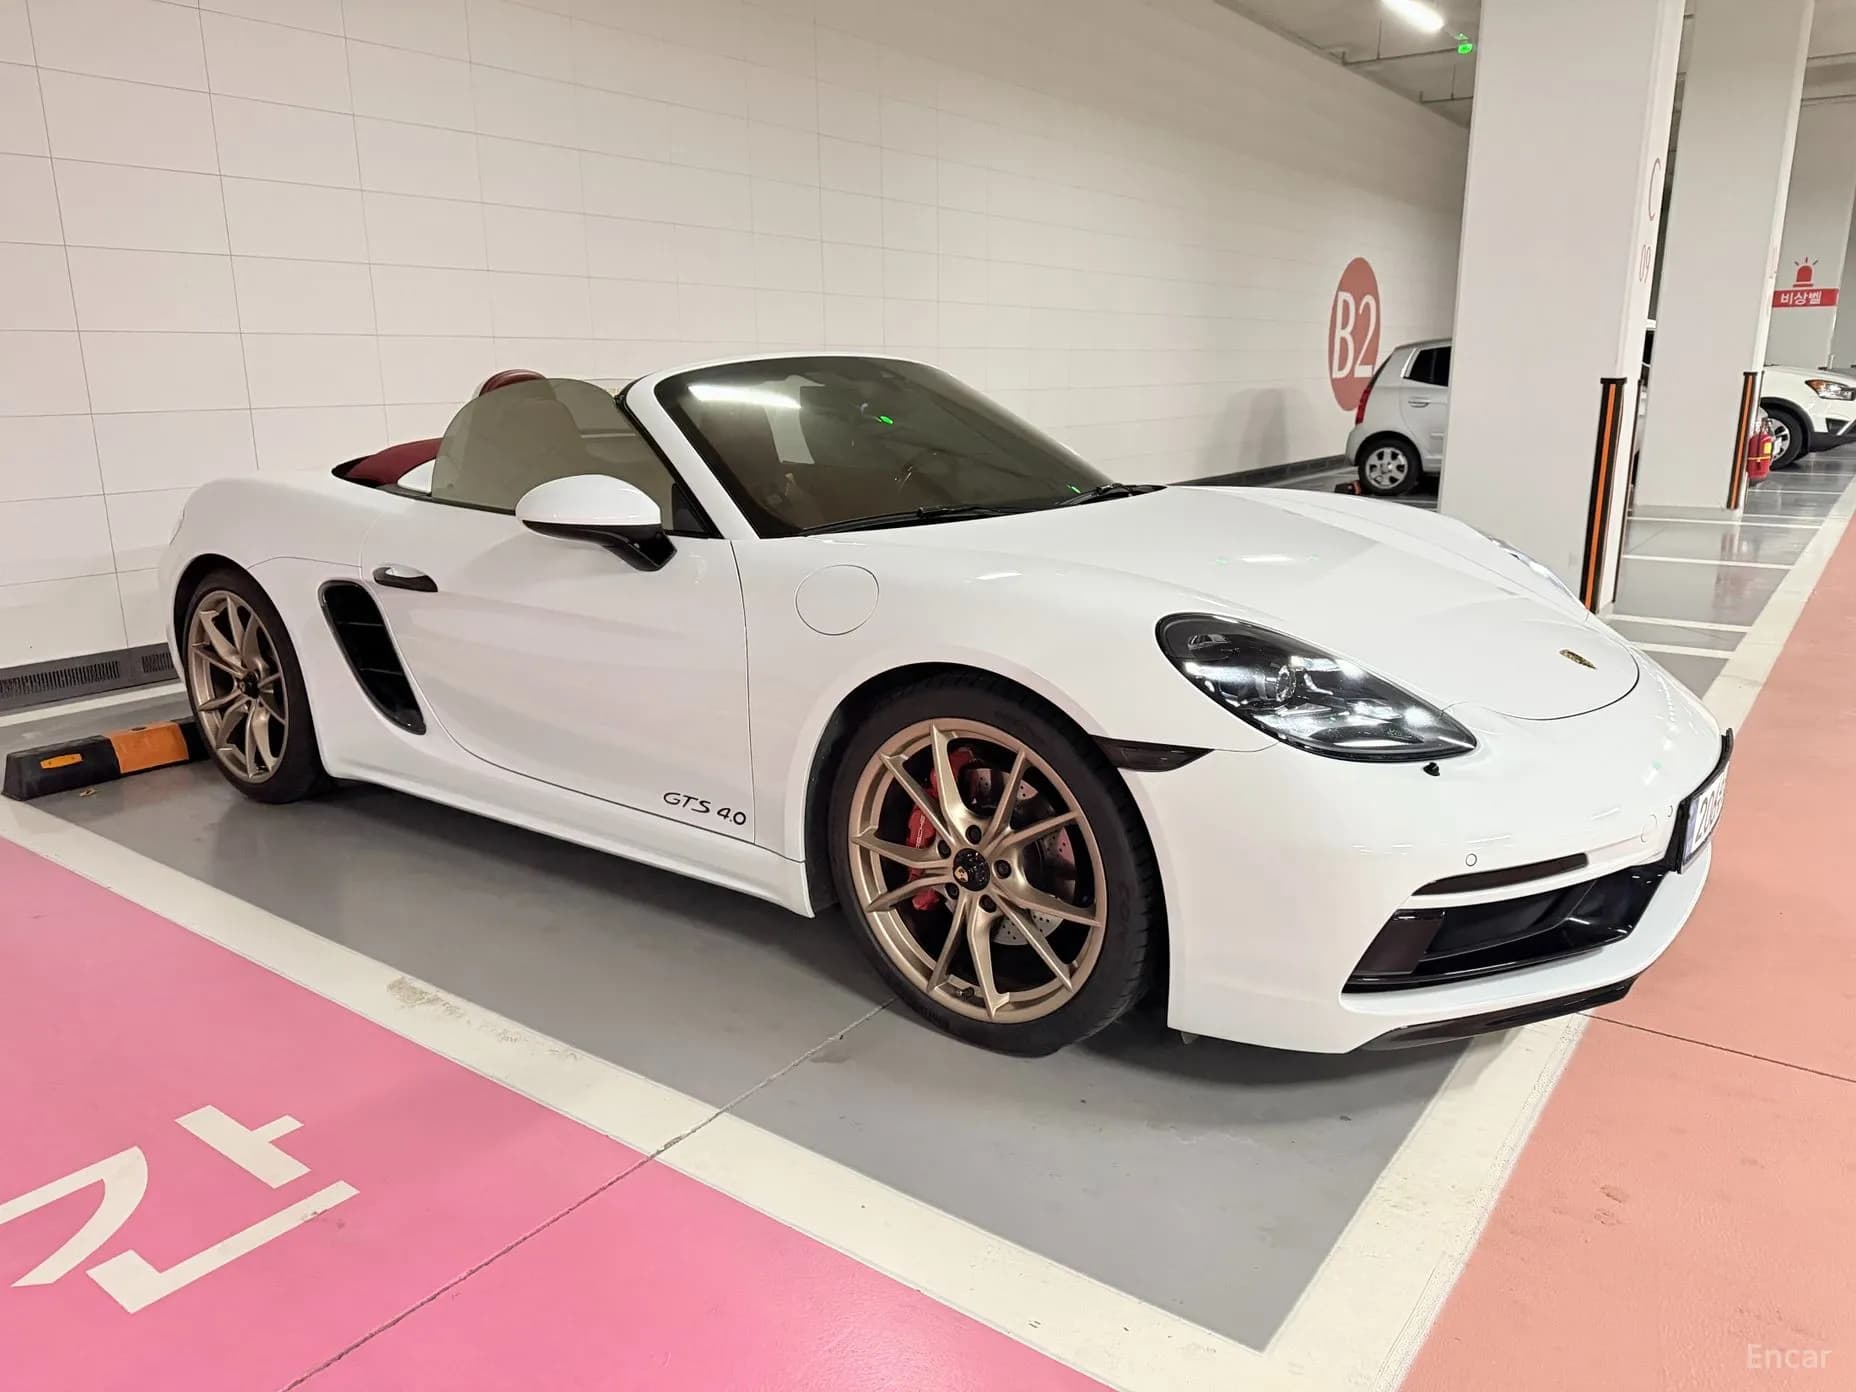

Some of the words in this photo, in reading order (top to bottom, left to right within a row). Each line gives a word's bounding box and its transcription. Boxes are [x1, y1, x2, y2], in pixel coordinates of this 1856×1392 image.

[1648, 157, 1661, 221] C
[1780, 290, 1822, 306] 비상벨
[1332, 291, 1377, 380] B2
[663, 791, 712, 814] GTS
[716, 807, 747, 826] 4.0
